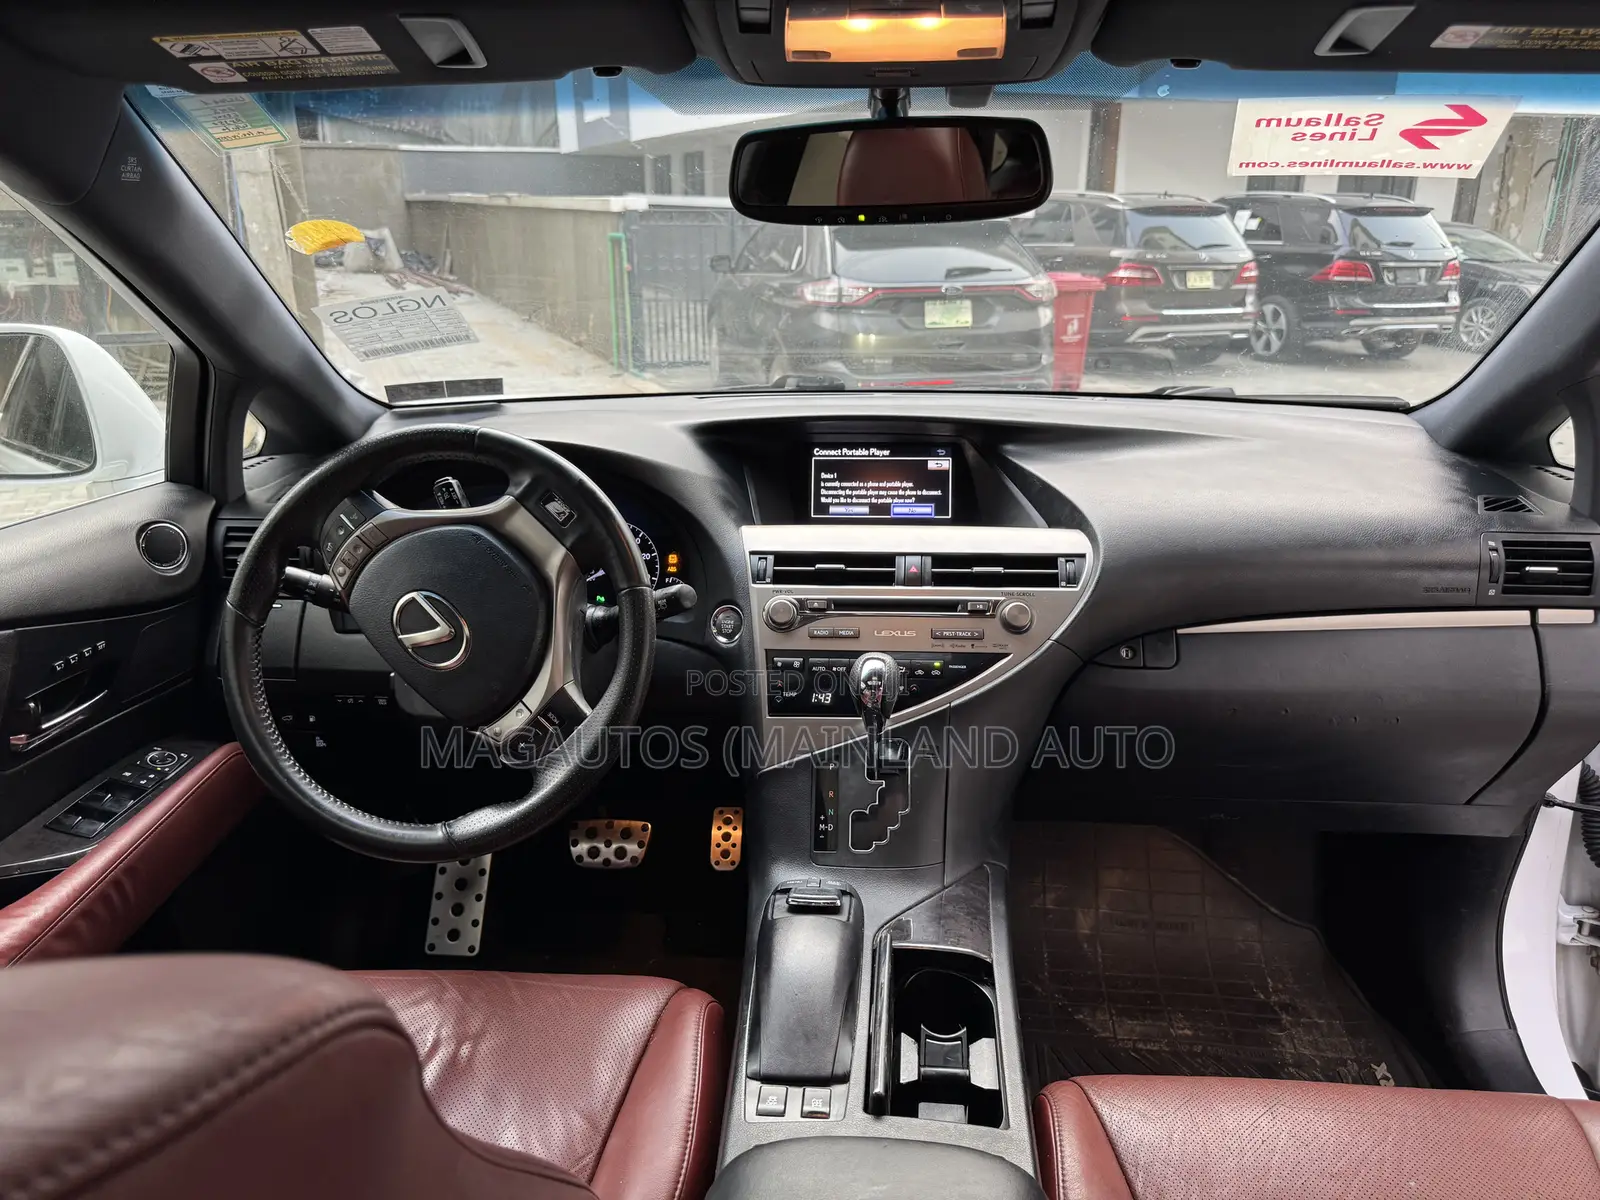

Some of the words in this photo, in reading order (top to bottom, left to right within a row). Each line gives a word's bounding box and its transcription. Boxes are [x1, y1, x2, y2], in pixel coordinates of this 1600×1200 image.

[231, 61, 260, 69] AIR
[265, 59, 298, 67] BAG
[302, 54, 387, 65] WARNING
[813, 447, 841, 456] Connect
[842, 447, 869, 456] Portable
[869, 447, 891, 457] Player
[811, 693, 832, 704] 1:43
